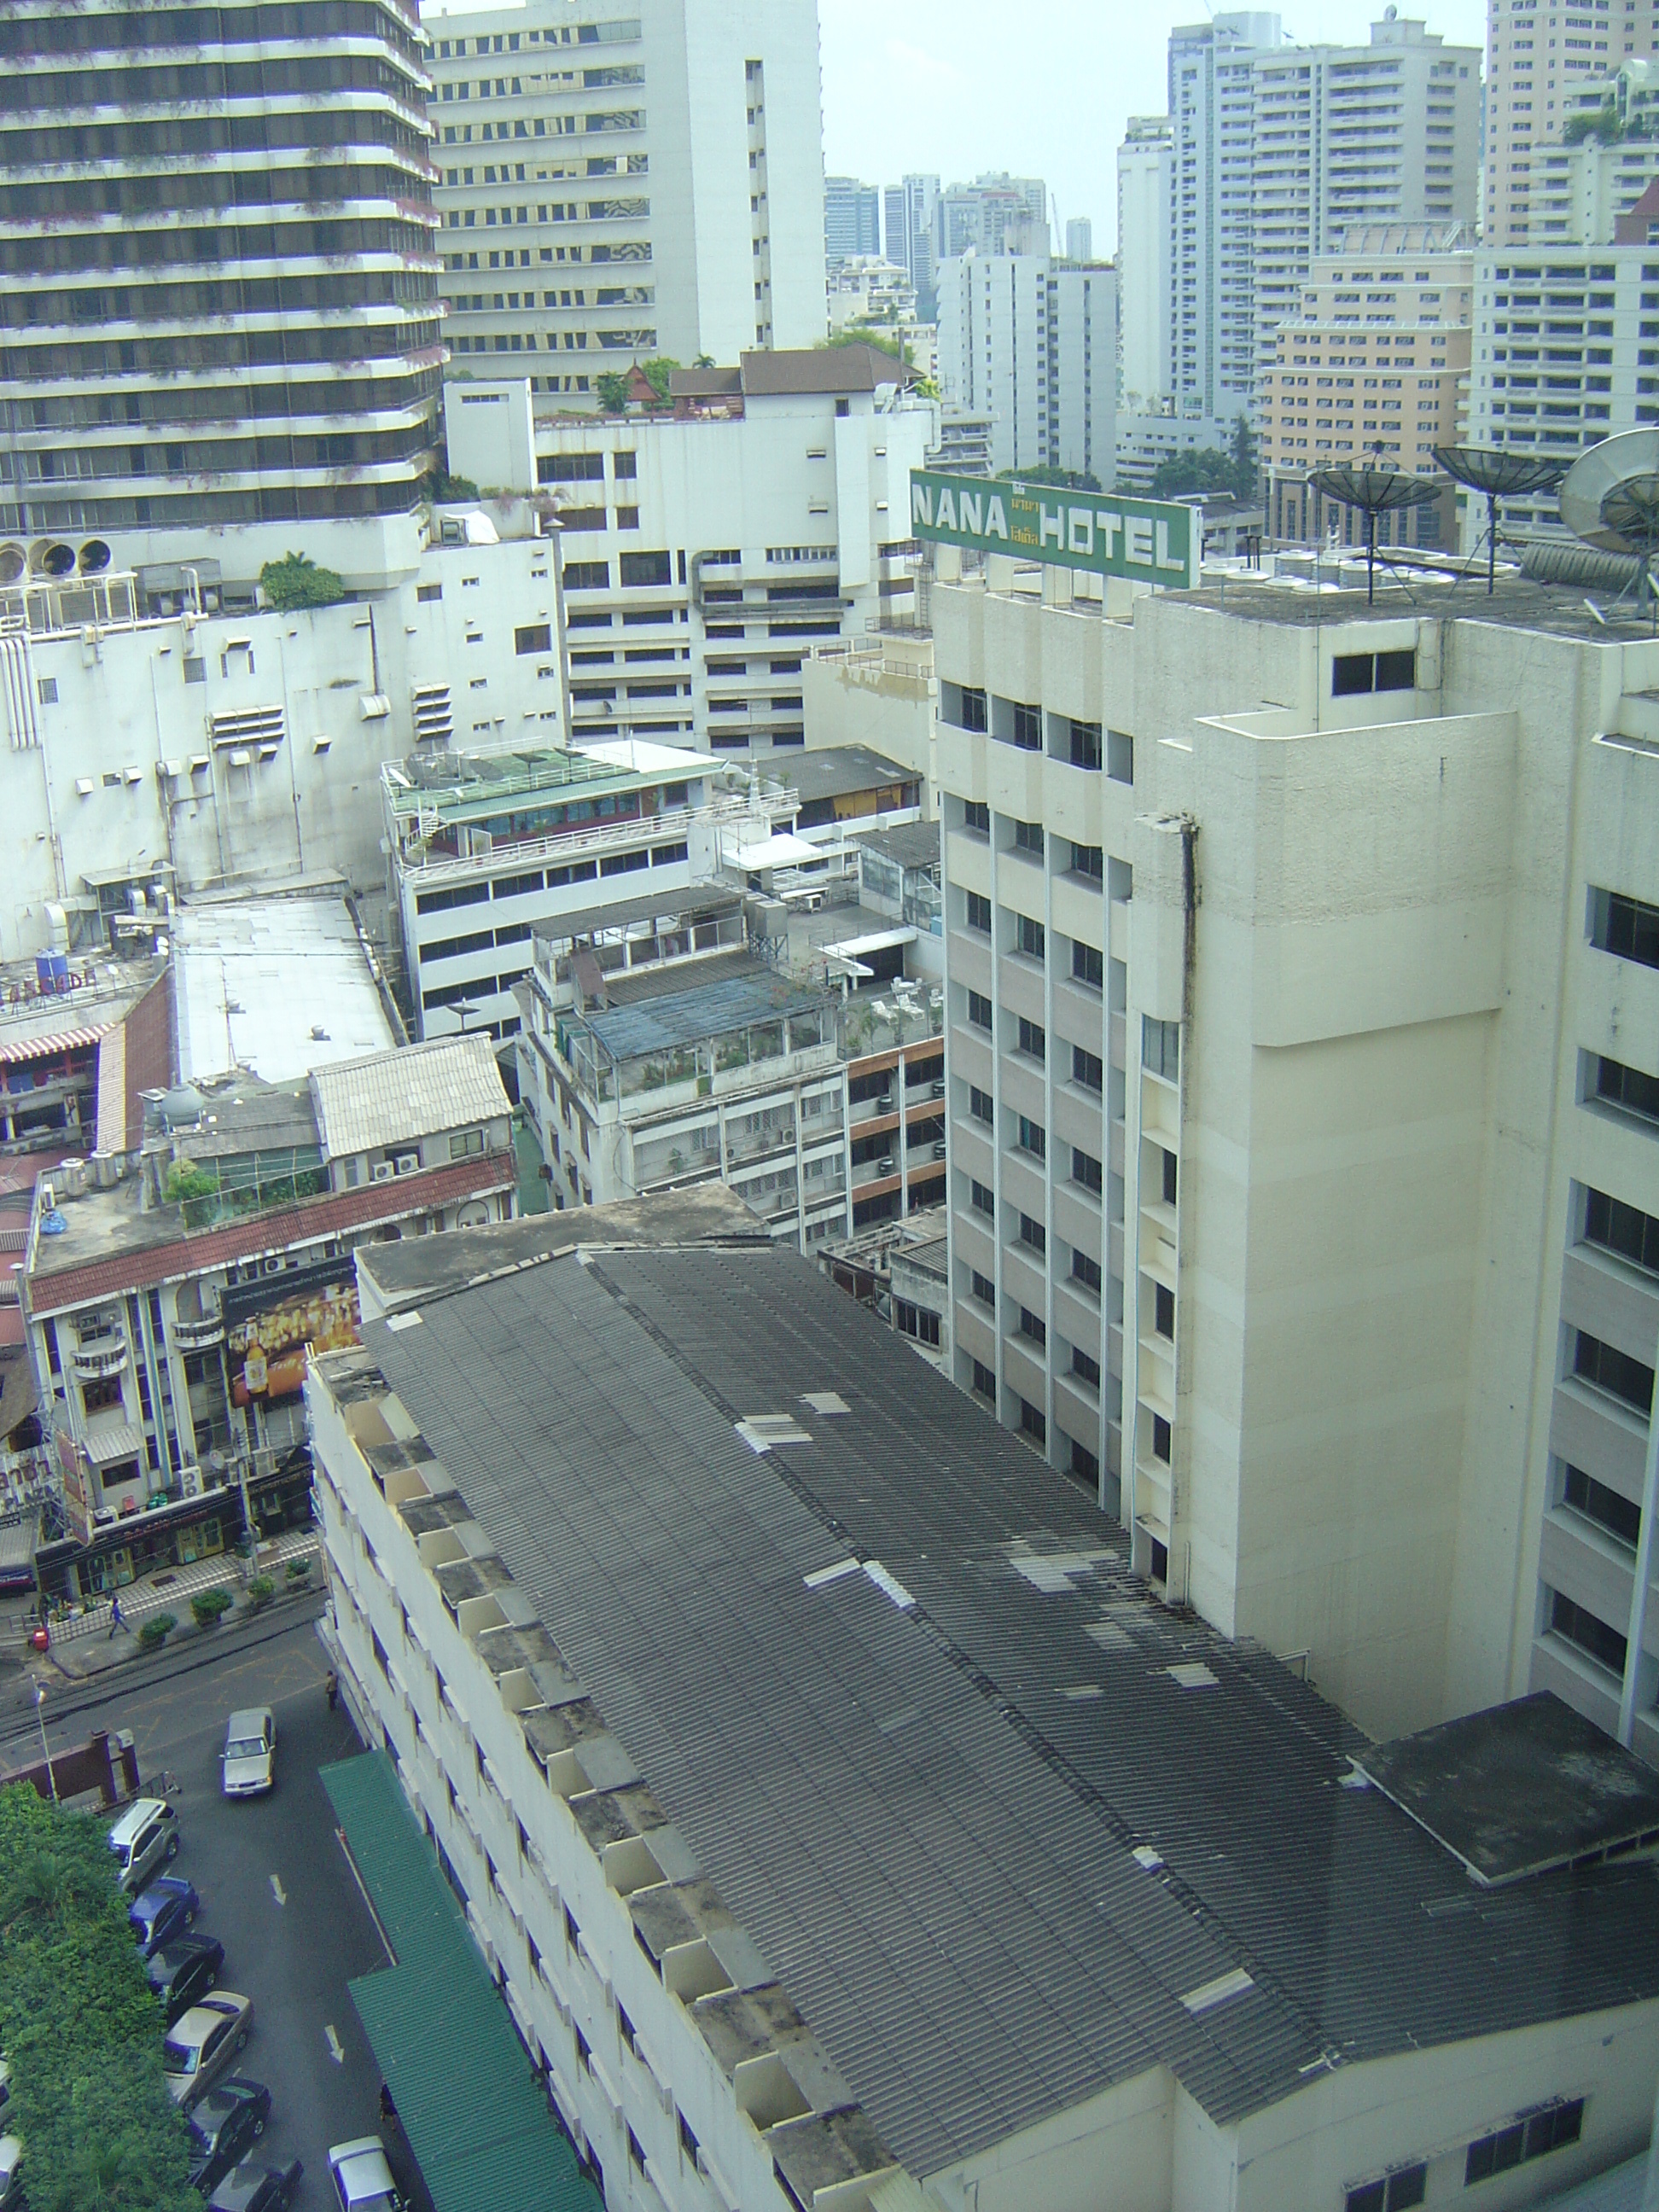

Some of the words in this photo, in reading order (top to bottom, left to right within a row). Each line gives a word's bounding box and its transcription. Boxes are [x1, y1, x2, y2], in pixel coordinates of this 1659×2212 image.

[911, 484, 1008, 539] NANA
[1039, 503, 1185, 572] HOTEL
[0, 967, 96, 1006] ASCADE
